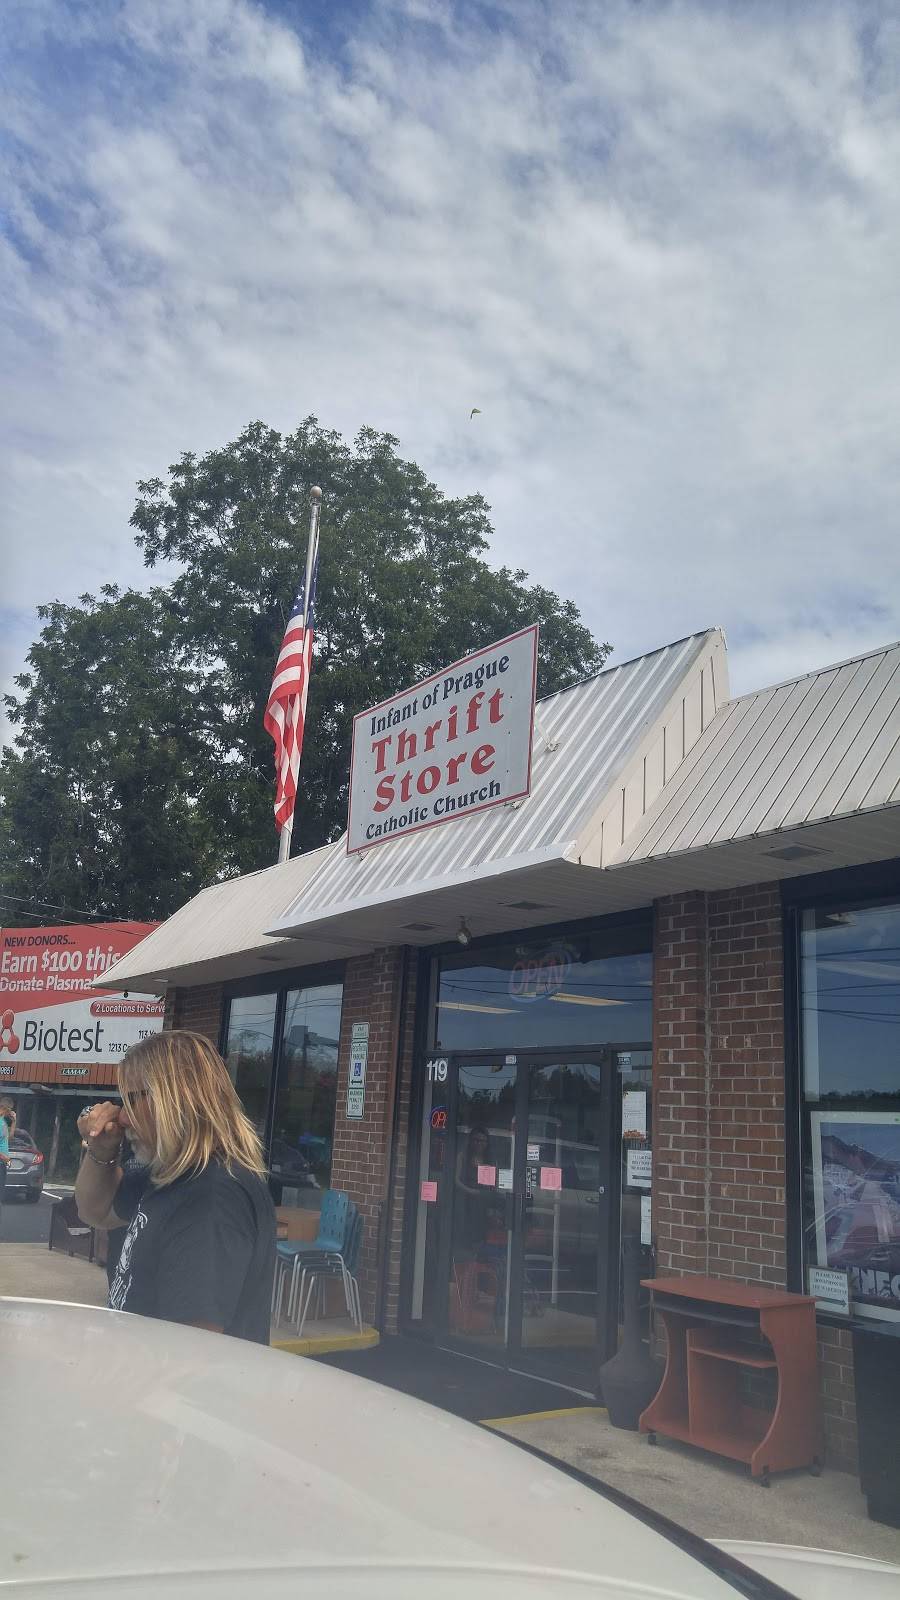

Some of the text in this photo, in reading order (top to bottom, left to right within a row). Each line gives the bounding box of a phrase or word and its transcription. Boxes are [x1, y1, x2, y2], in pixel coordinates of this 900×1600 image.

[370, 655, 510, 736] Infant of Prague
[371, 688, 505, 774] Thrift
[372, 743, 496, 812] Store
[366, 779, 501, 840] Catholic Church
[4, 934, 76, 947] NEW DONORS...
[1, 945, 121, 974] Earn $100 this
[0, 976, 44, 992] Donate
[95, 1003, 100, 1013] 2
[101, 1003, 136, 1013] Locations
[136, 1003, 145, 1013] to
[23, 1020, 105, 1053] Biotest
[108, 1043, 122, 1052] 1213
[426, 1059, 448, 1081] 119
